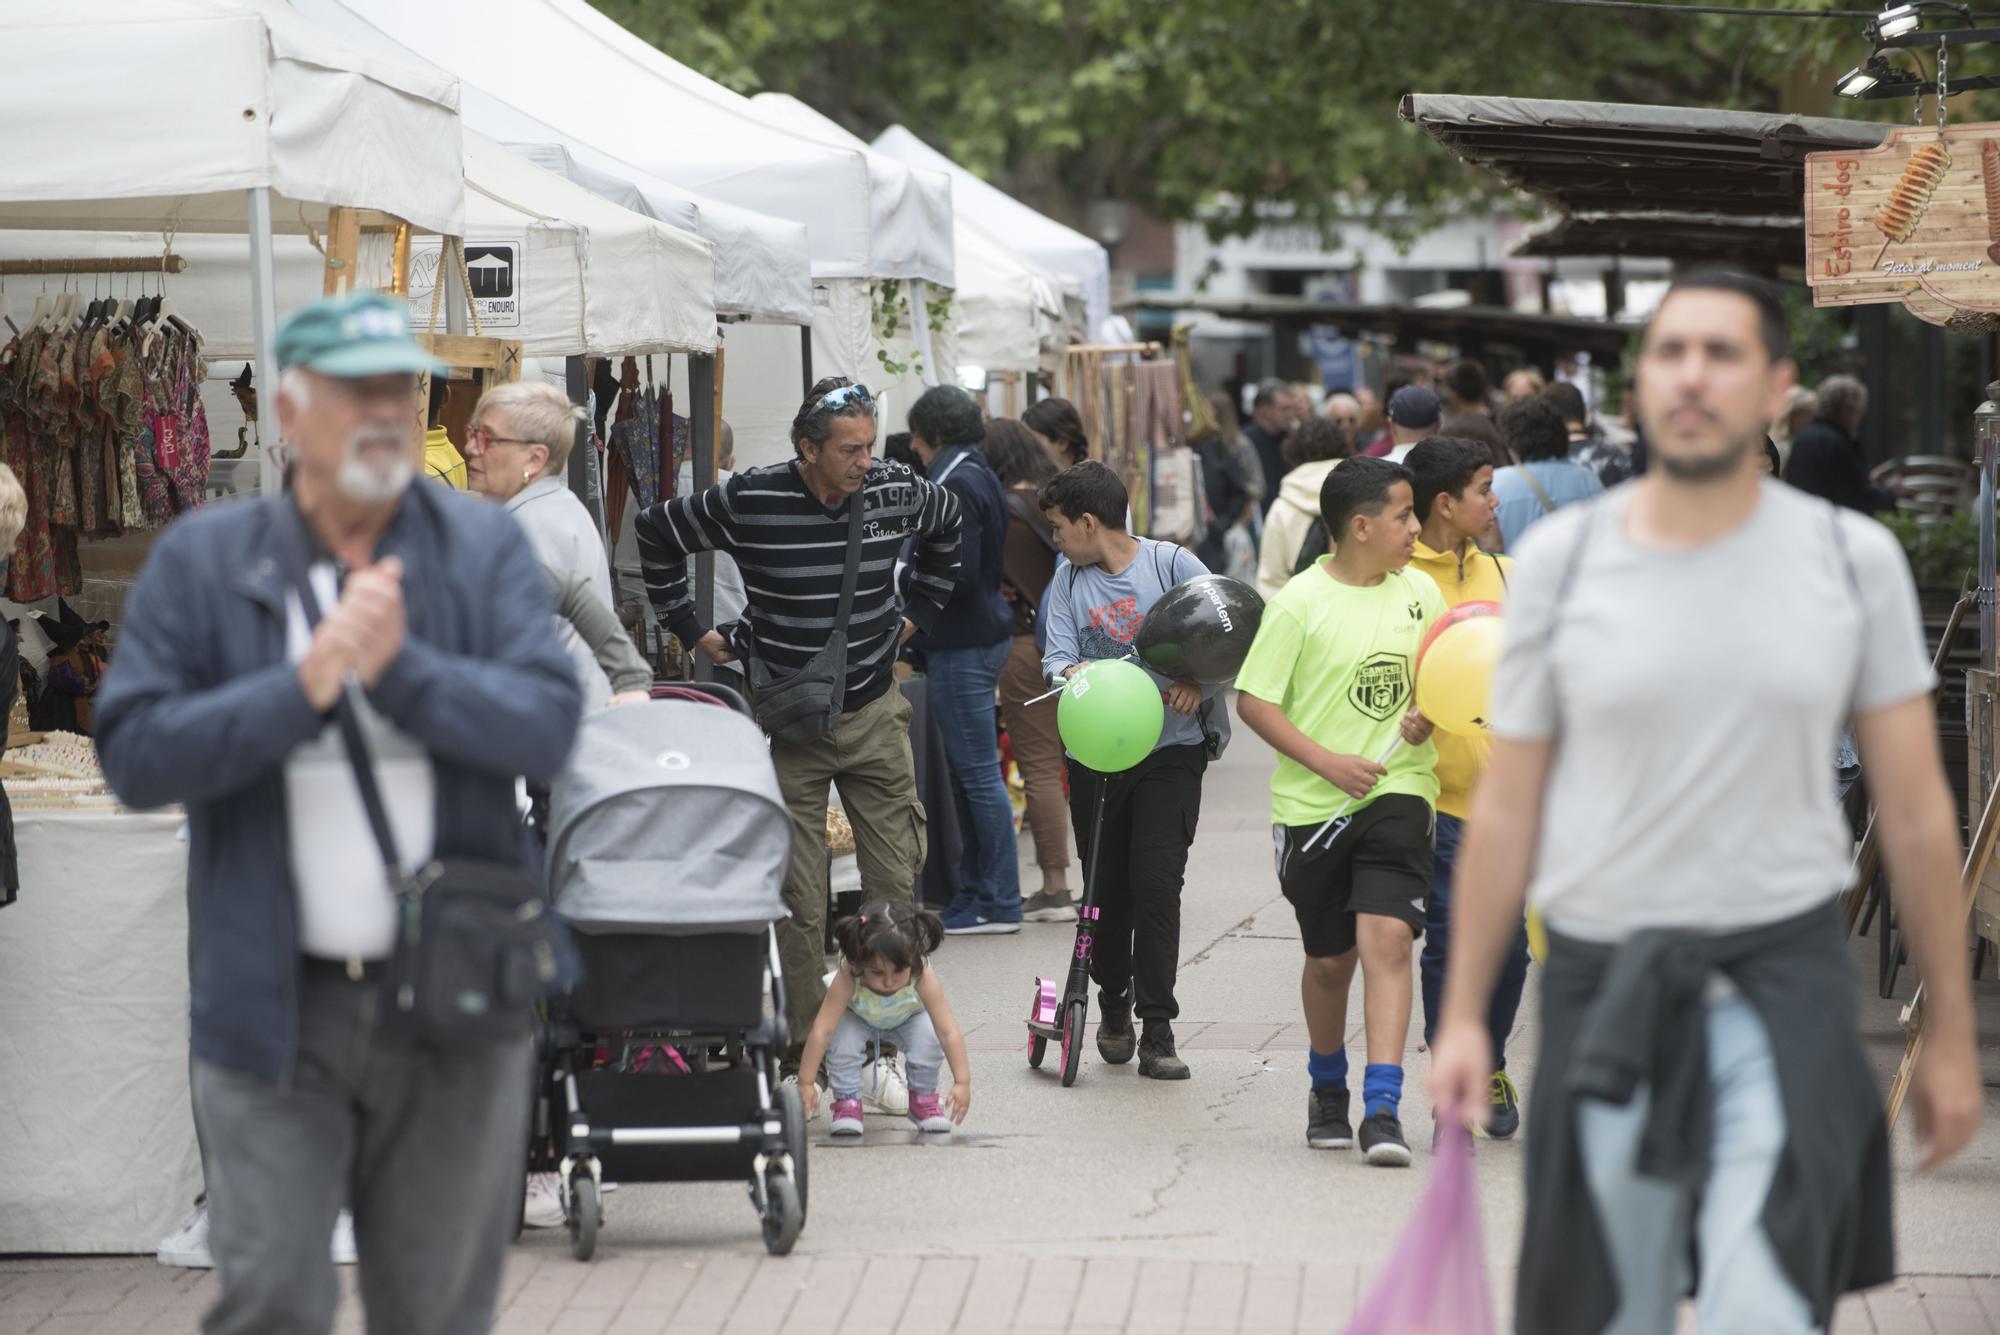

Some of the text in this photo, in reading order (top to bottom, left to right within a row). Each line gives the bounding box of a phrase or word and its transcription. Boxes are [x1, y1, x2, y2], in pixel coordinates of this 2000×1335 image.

[1936, 260, 1983, 272] moment
[488, 301, 514, 313] ENDURO
[1203, 587, 1233, 633] parlem
